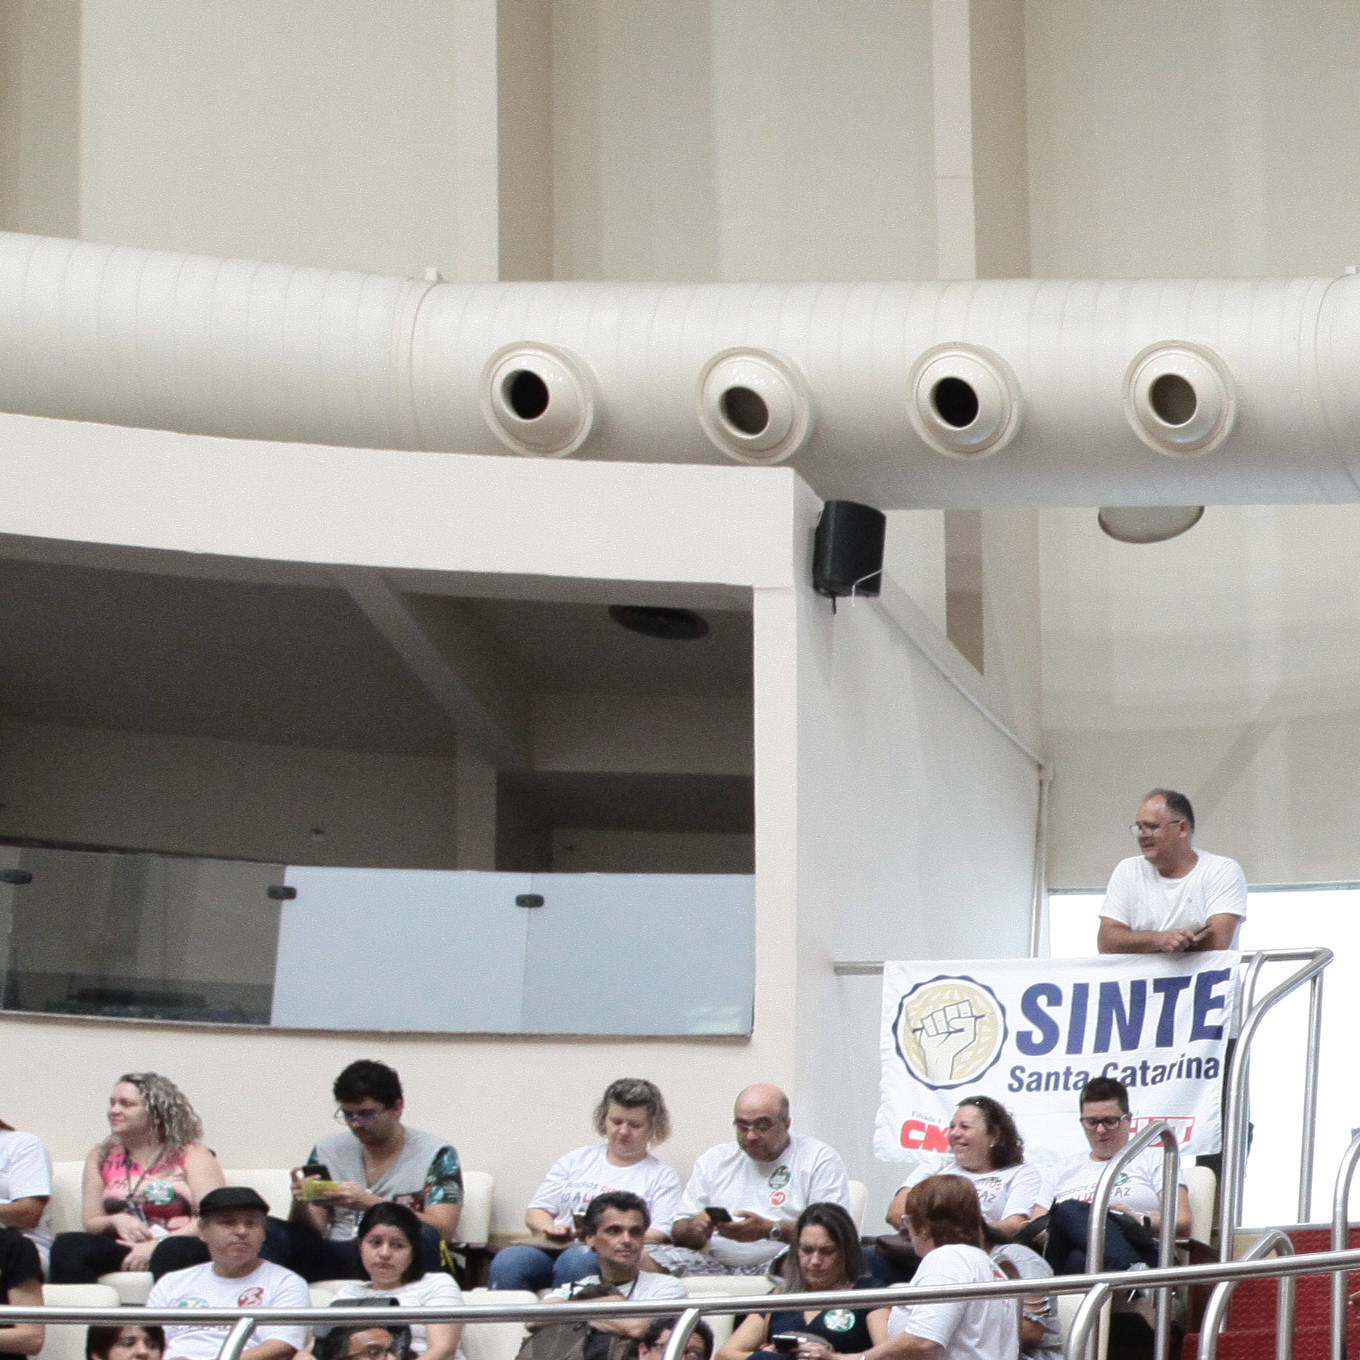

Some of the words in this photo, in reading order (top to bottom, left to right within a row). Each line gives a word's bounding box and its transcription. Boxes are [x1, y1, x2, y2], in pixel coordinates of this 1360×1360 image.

[1016, 968, 1231, 1056] SINTE
[1008, 1065, 1091, 1093] Santa
[1102, 1053, 1220, 1087] Catarina
